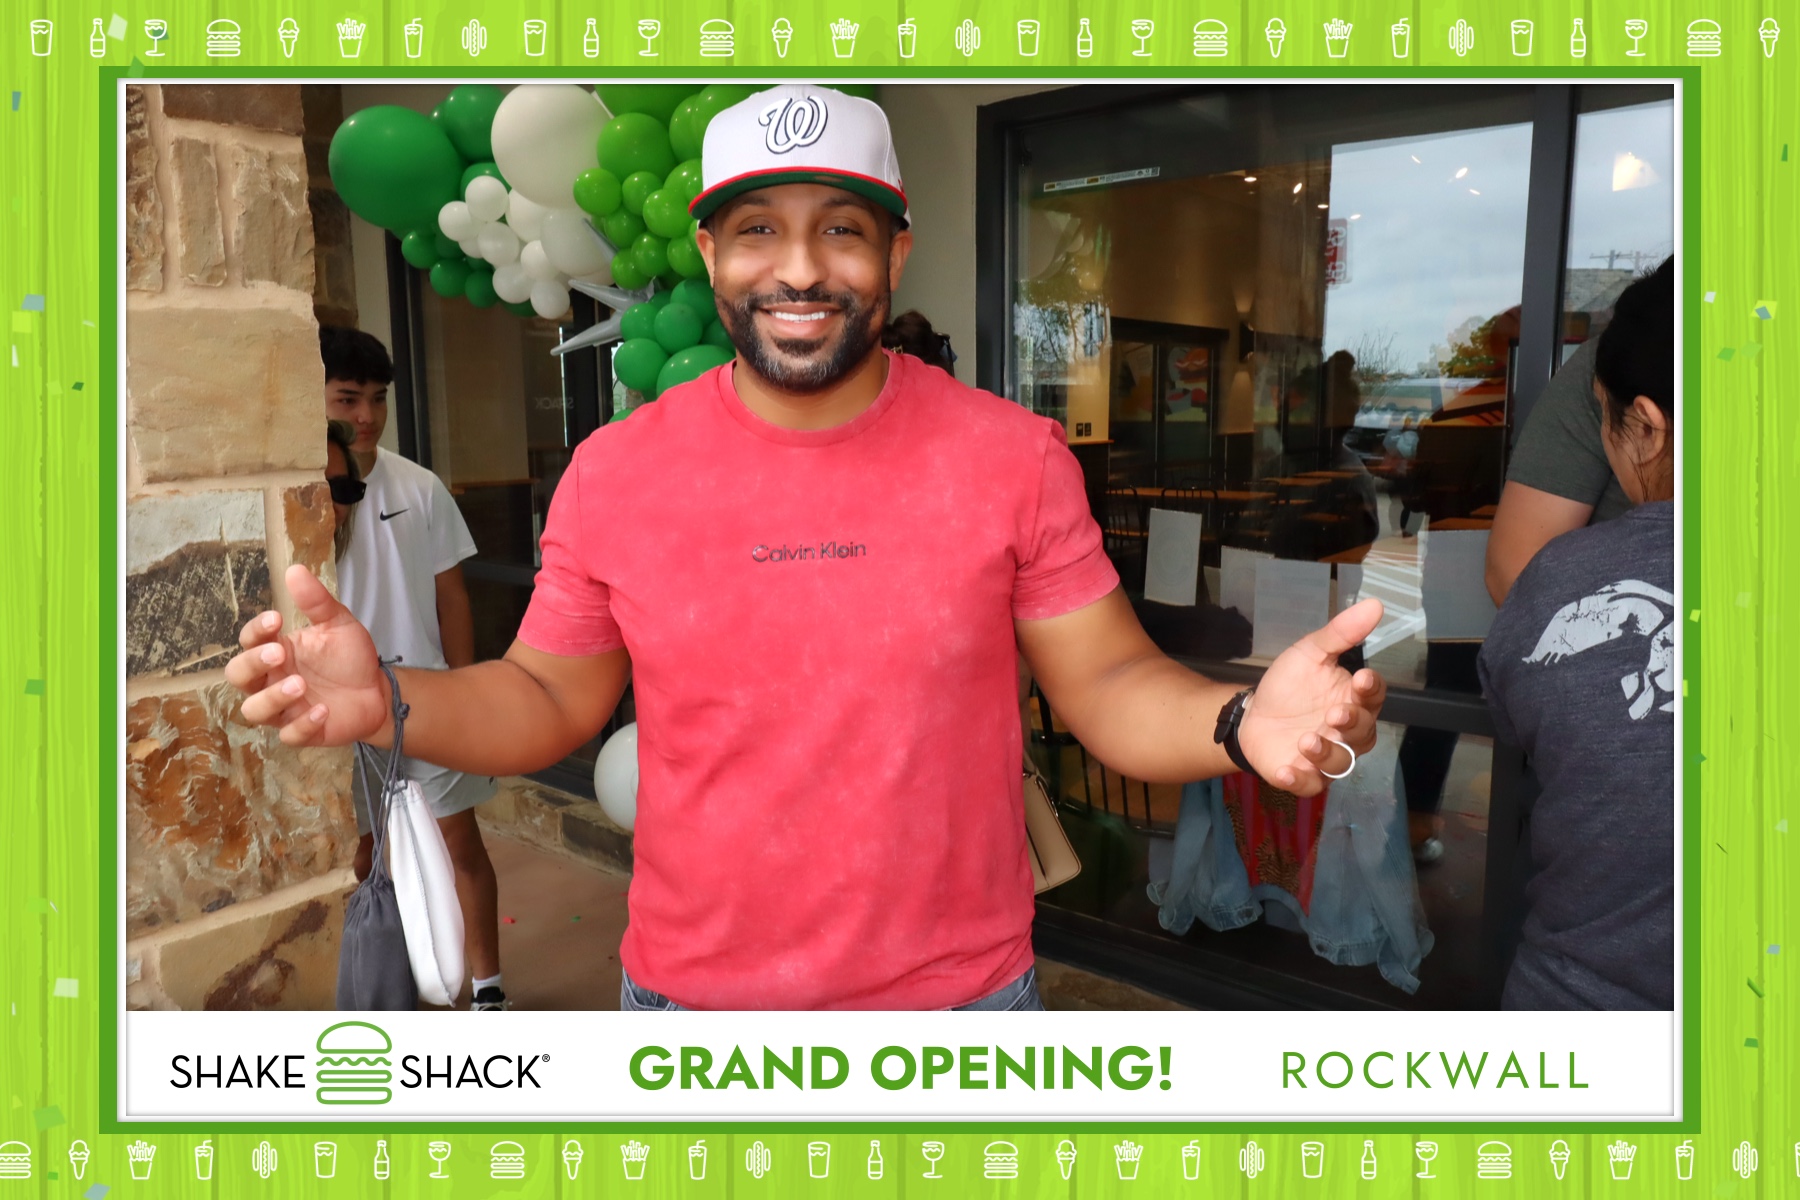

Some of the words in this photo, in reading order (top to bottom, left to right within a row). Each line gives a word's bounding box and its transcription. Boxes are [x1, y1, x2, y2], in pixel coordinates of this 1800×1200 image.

[758, 95, 828, 155] W
[752, 544, 816, 563] Calvin
[820, 541, 867, 560] Klein
